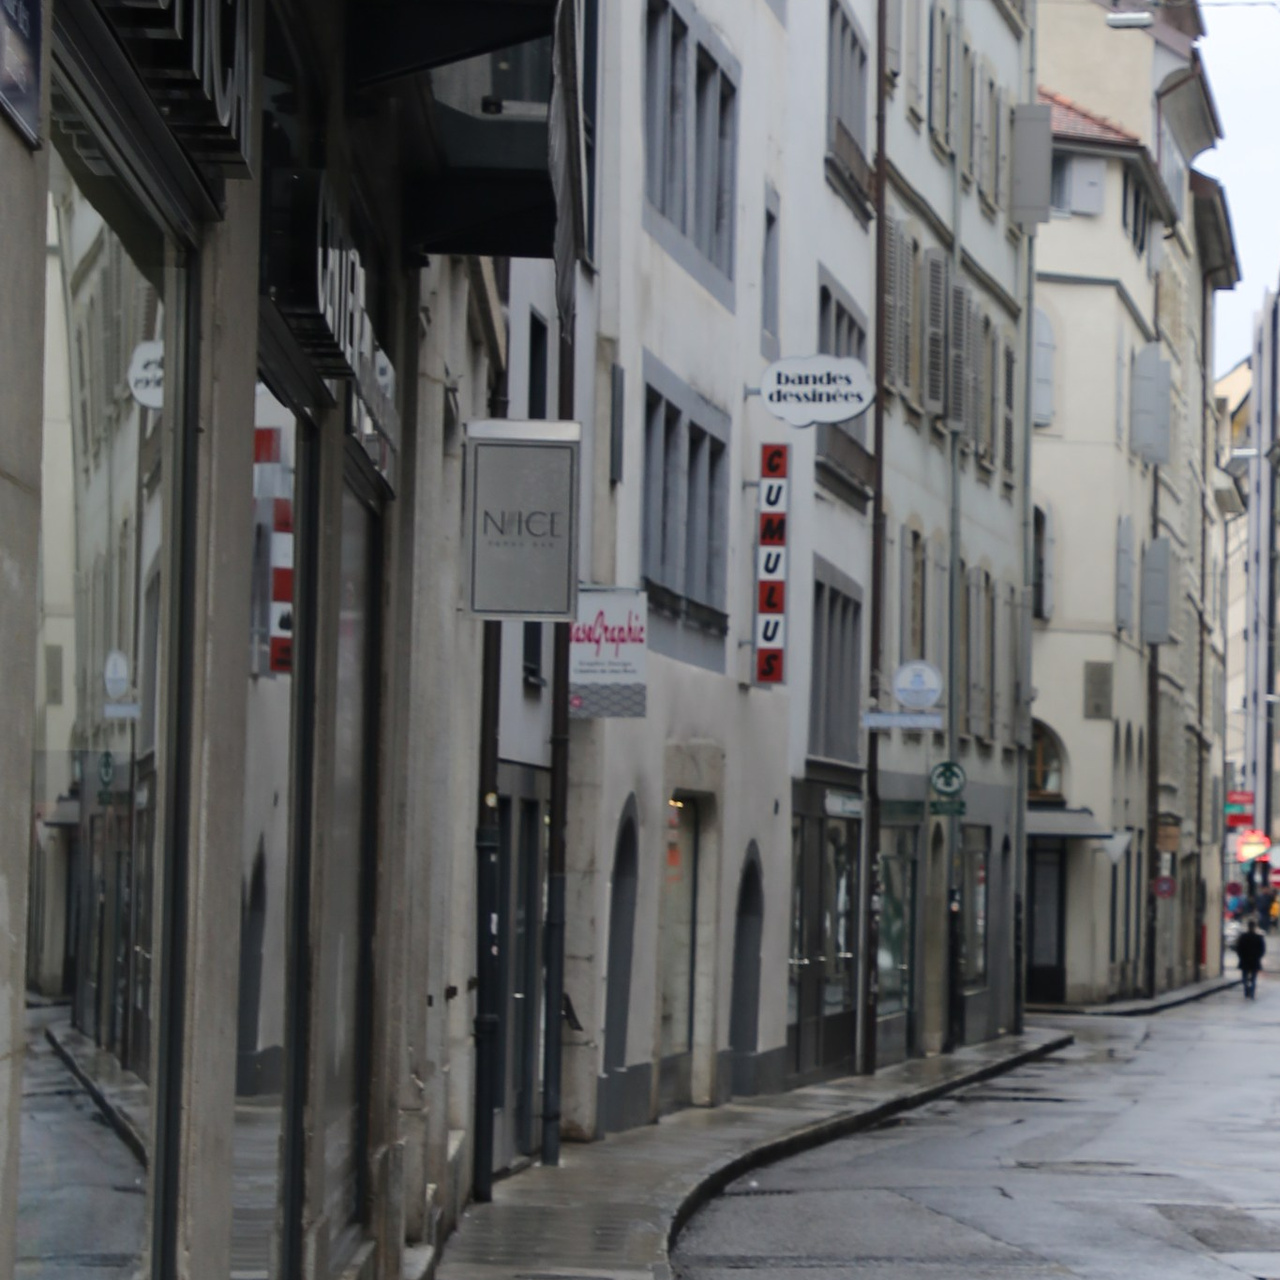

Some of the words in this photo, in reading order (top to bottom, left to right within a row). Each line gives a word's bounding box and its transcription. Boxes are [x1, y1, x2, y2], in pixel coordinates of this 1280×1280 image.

[776, 371, 852, 385] bandes
[768, 388, 864, 402] dessinées
[761, 450, 785, 676] CUMULUS
